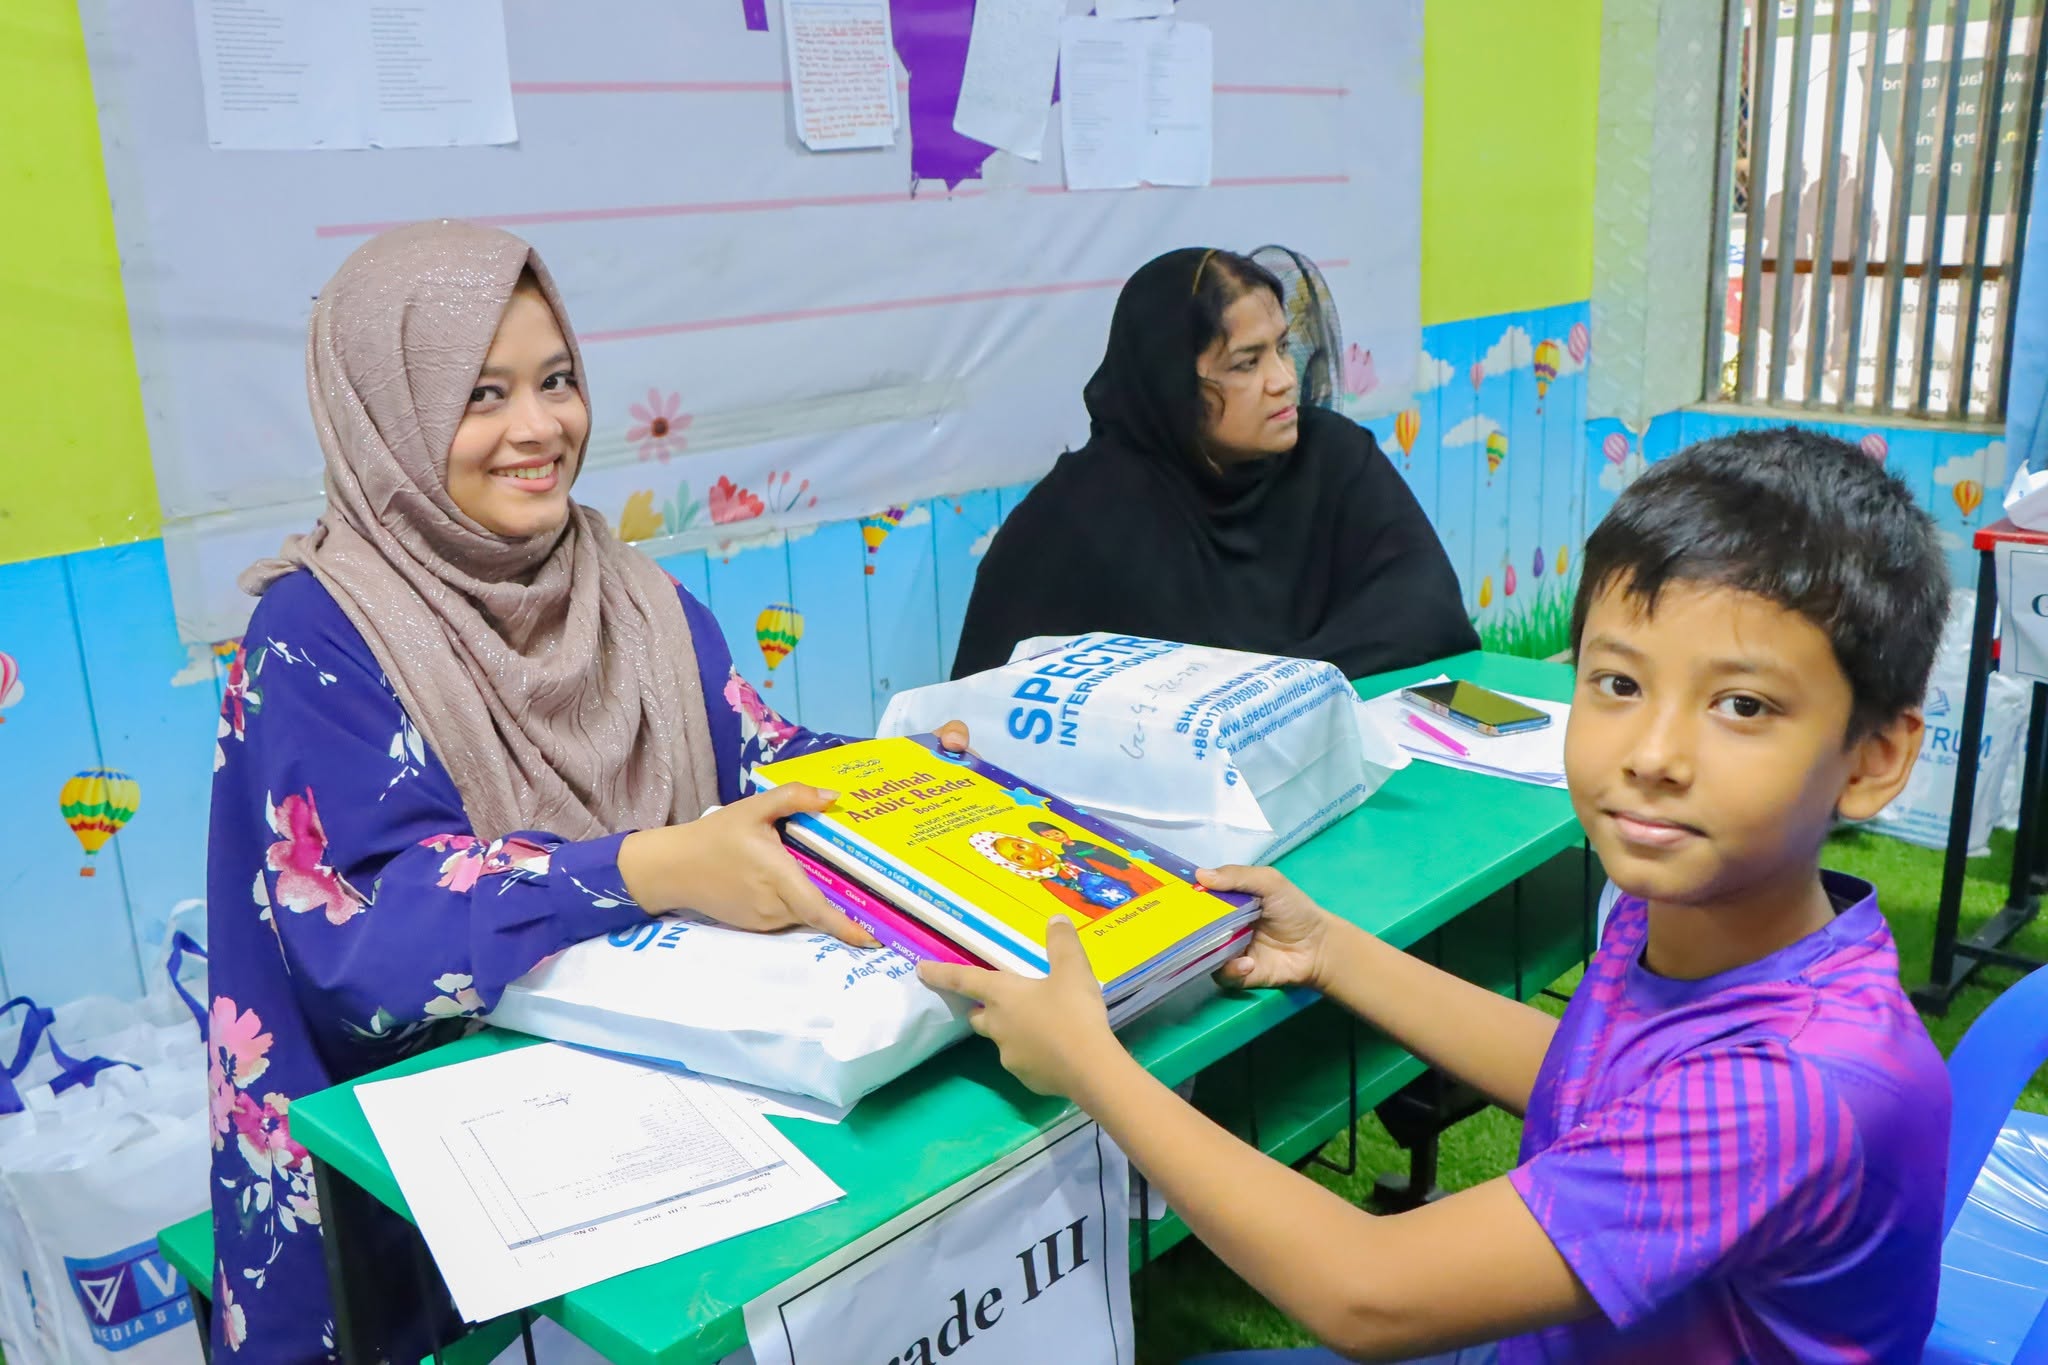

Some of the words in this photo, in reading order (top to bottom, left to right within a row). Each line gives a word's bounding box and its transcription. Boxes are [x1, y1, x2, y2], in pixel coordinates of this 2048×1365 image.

[1060, 648, 1173, 747] INTERNATIONAL
[847, 795, 915, 823] Arabic
[909, 777, 976, 801] Reader
[850, 771, 935, 803] Madinah
[910, 823, 944, 838] LANGUAGE
[927, 827, 953, 839] ISLAMIC
[1094, 928, 1109, 937] Dr.
[1114, 911, 1138, 925] Abdur
[1136, 899, 1161, 913] Rahim
[892, 940, 916, 961] Science
[586, 1226, 599, 1235] ID
[1016, 1215, 1089, 1304] III
